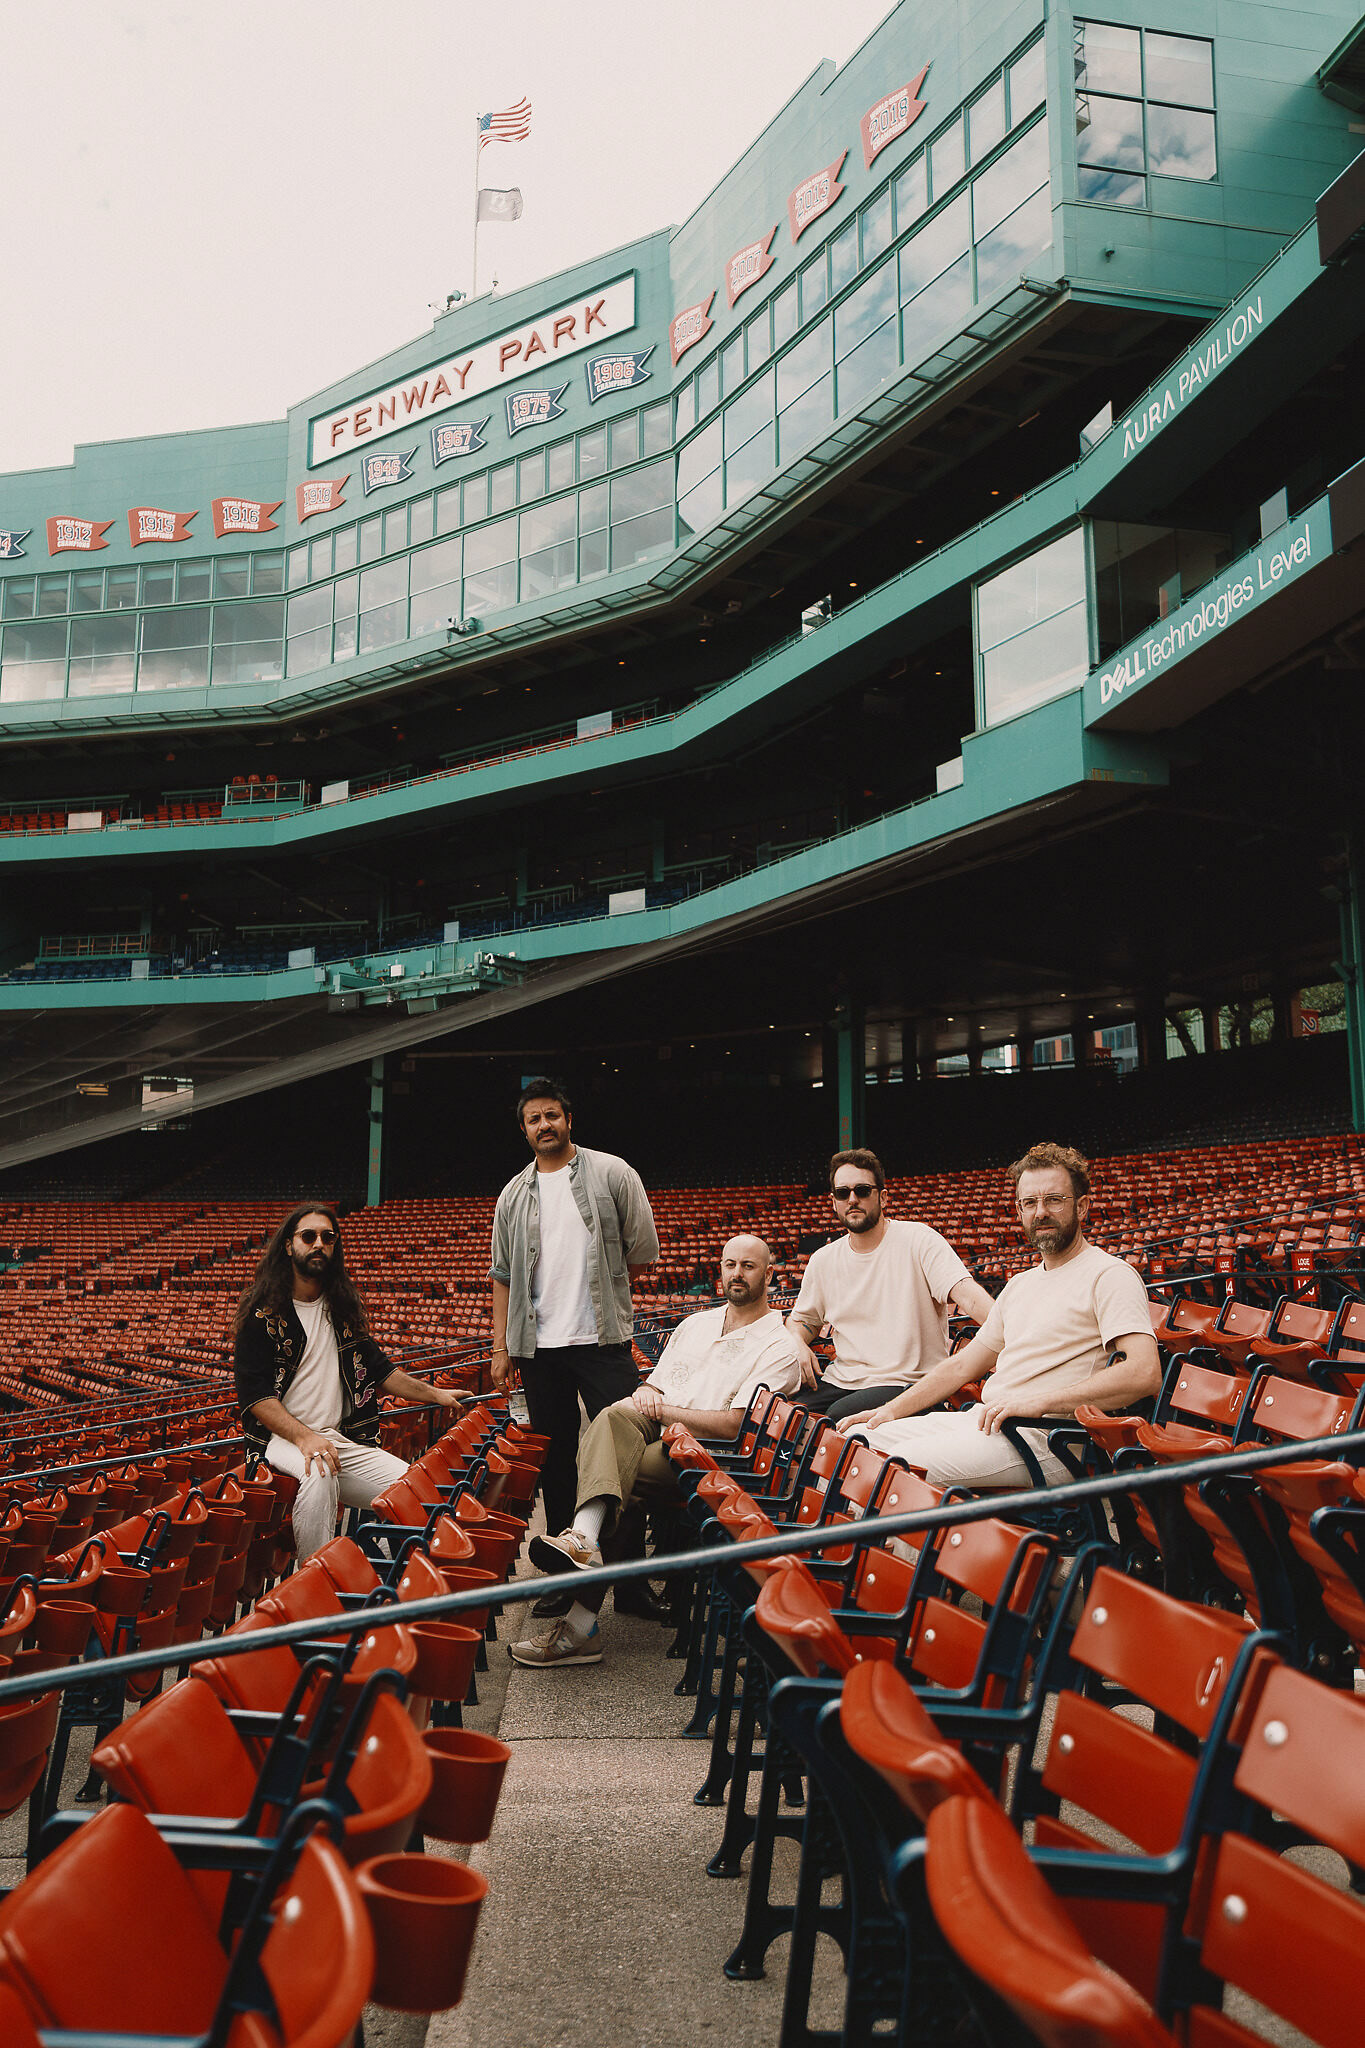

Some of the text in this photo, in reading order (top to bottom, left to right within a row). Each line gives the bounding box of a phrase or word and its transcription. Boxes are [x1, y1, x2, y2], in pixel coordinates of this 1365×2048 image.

[869, 96, 909, 146] 2018
[795, 179, 830, 221] 2013
[731, 249, 763, 289] 2007
[674, 312, 703, 349] 2004
[1178, 296, 1263, 401] PAVILION
[331, 299, 607, 447] FENWAY PARK
[594, 361, 636, 387] 1986
[512, 396, 551, 421] 1975
[437, 429, 473, 453] 1967
[368, 460, 401, 482] 1946
[304, 488, 332, 508] 1918
[139, 516, 175, 534] 1915
[223, 506, 260, 524] 1916
[57, 525, 92, 542] 1912
[1100, 523, 1312, 704] DELL Technologies Level
[1301, 1015, 1317, 1036] 2
[1297, 1258, 1310, 1266] LOGE
[1225, 1280, 1234, 1294] 4
[779, 1449, 791, 1460] K
